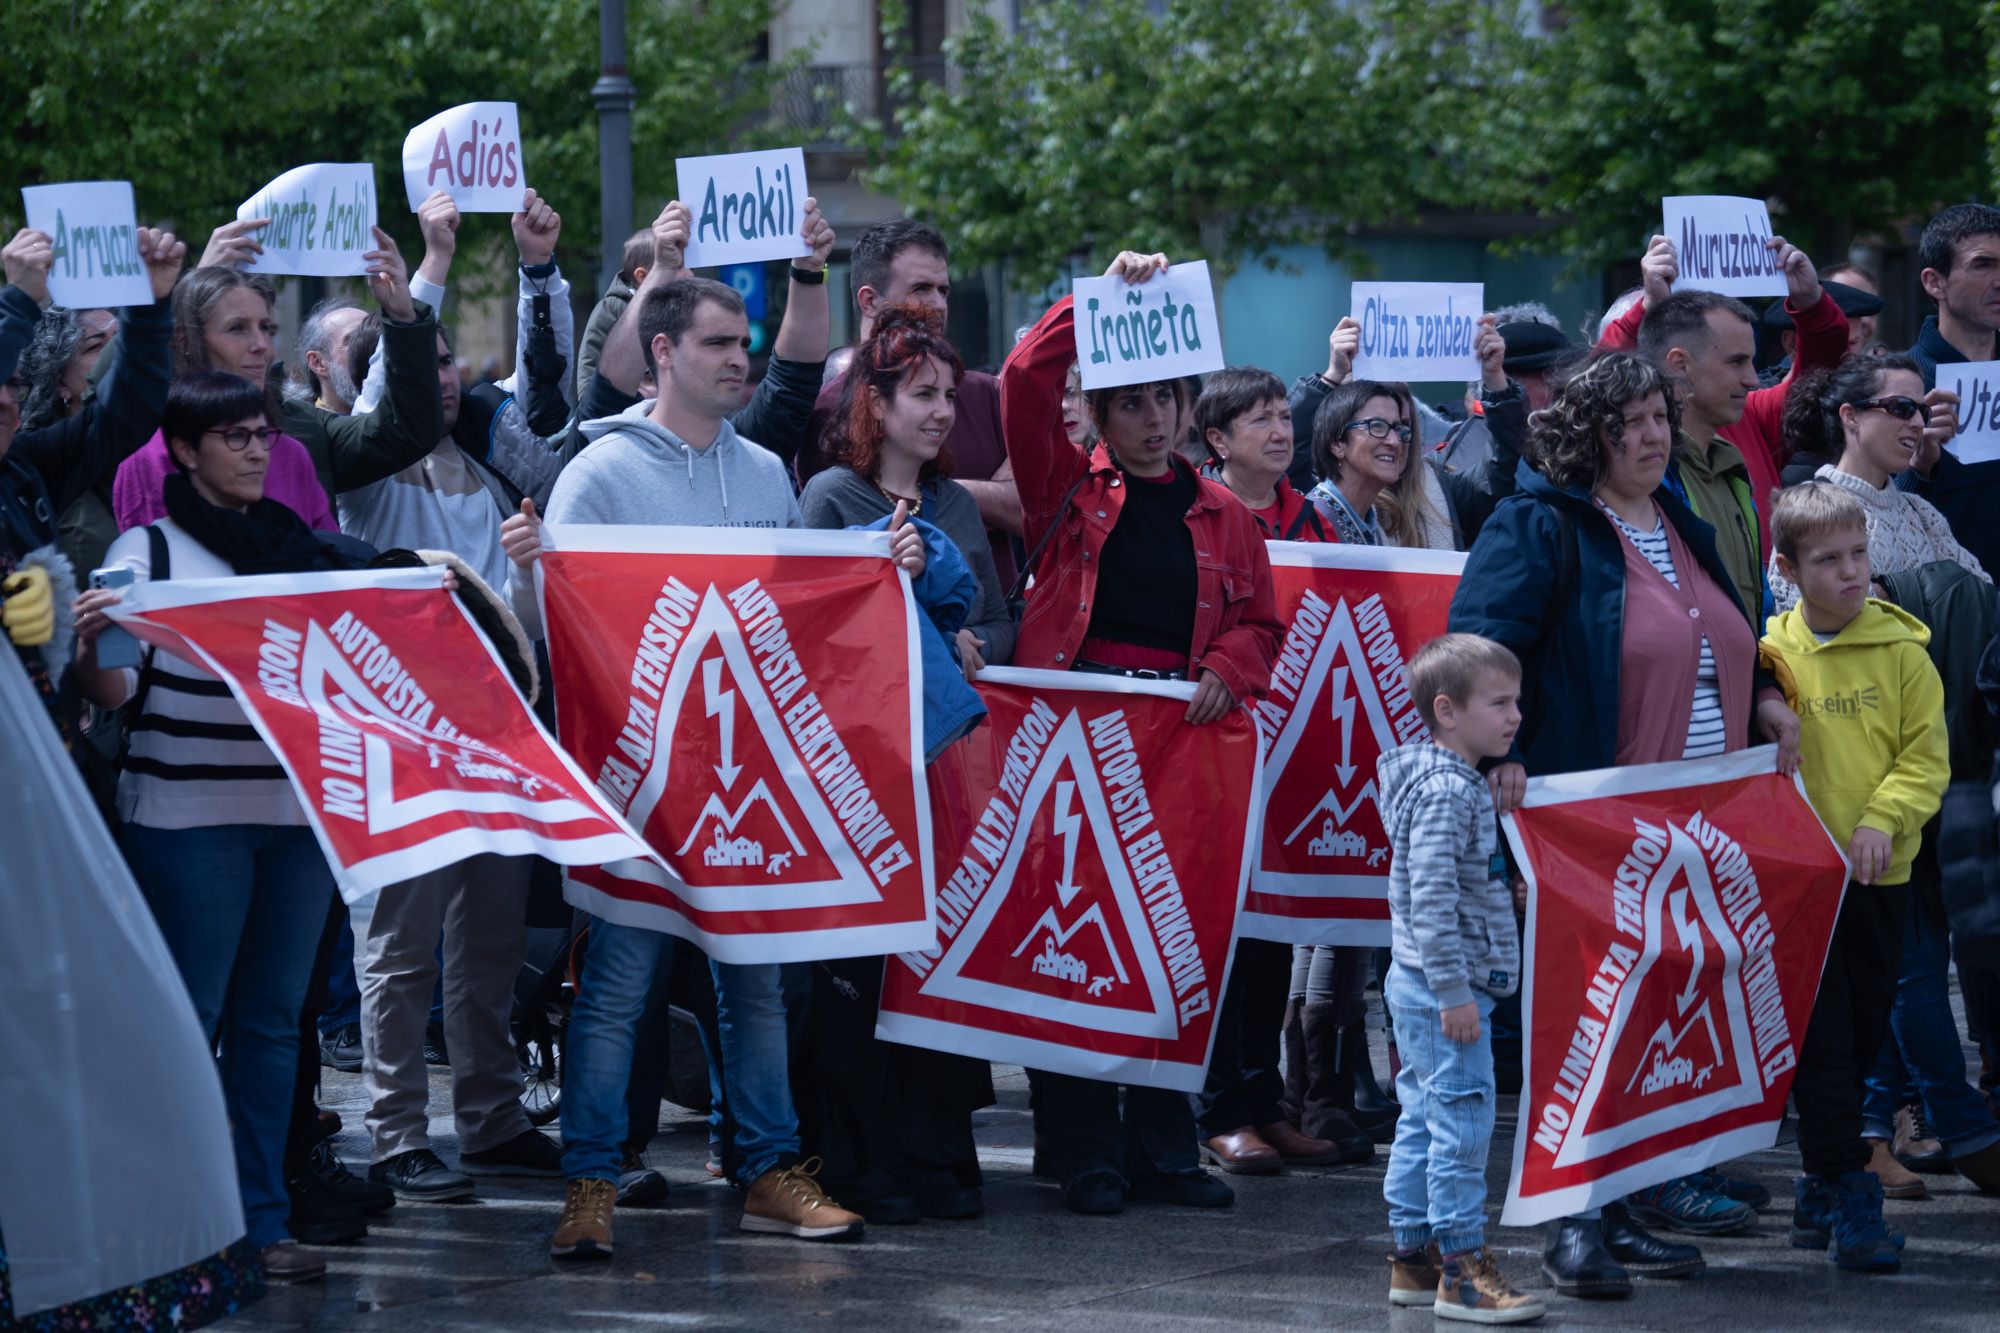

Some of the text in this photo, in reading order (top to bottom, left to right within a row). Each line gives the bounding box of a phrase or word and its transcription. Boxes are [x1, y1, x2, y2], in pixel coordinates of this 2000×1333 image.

[427, 117, 517, 188] Adiós
[698, 163, 793, 243] Arakil
[321, 180, 369, 251] Arakil
[1087, 289, 1201, 364] Irañeta
[1363, 293, 1472, 358] Oltza zendea
[328, 610, 435, 734] AUTOPISTA
[631, 575, 699, 701] TENSION
[1270, 588, 1331, 702] TENSION
[1353, 593, 1412, 717] AUTOPISTA
[615, 695, 656, 771] ALTA
[727, 578, 913, 887] AUTOPISTA ELEKTRIKORIK EZ
[321, 777, 366, 823] NO
[936, 856, 992, 940] LINEA
[970, 797, 1017, 869] ALTA
[999, 696, 1059, 807] TENSION
[1087, 709, 1211, 1027] AUTOPISTA ELEKTRIKORIK EZ
[1533, 816, 1670, 1155] NO LINEA ALTA TENSION
[1684, 809, 1762, 932] AUTOPISTA
[1762, 1043, 1797, 1089] EZ
